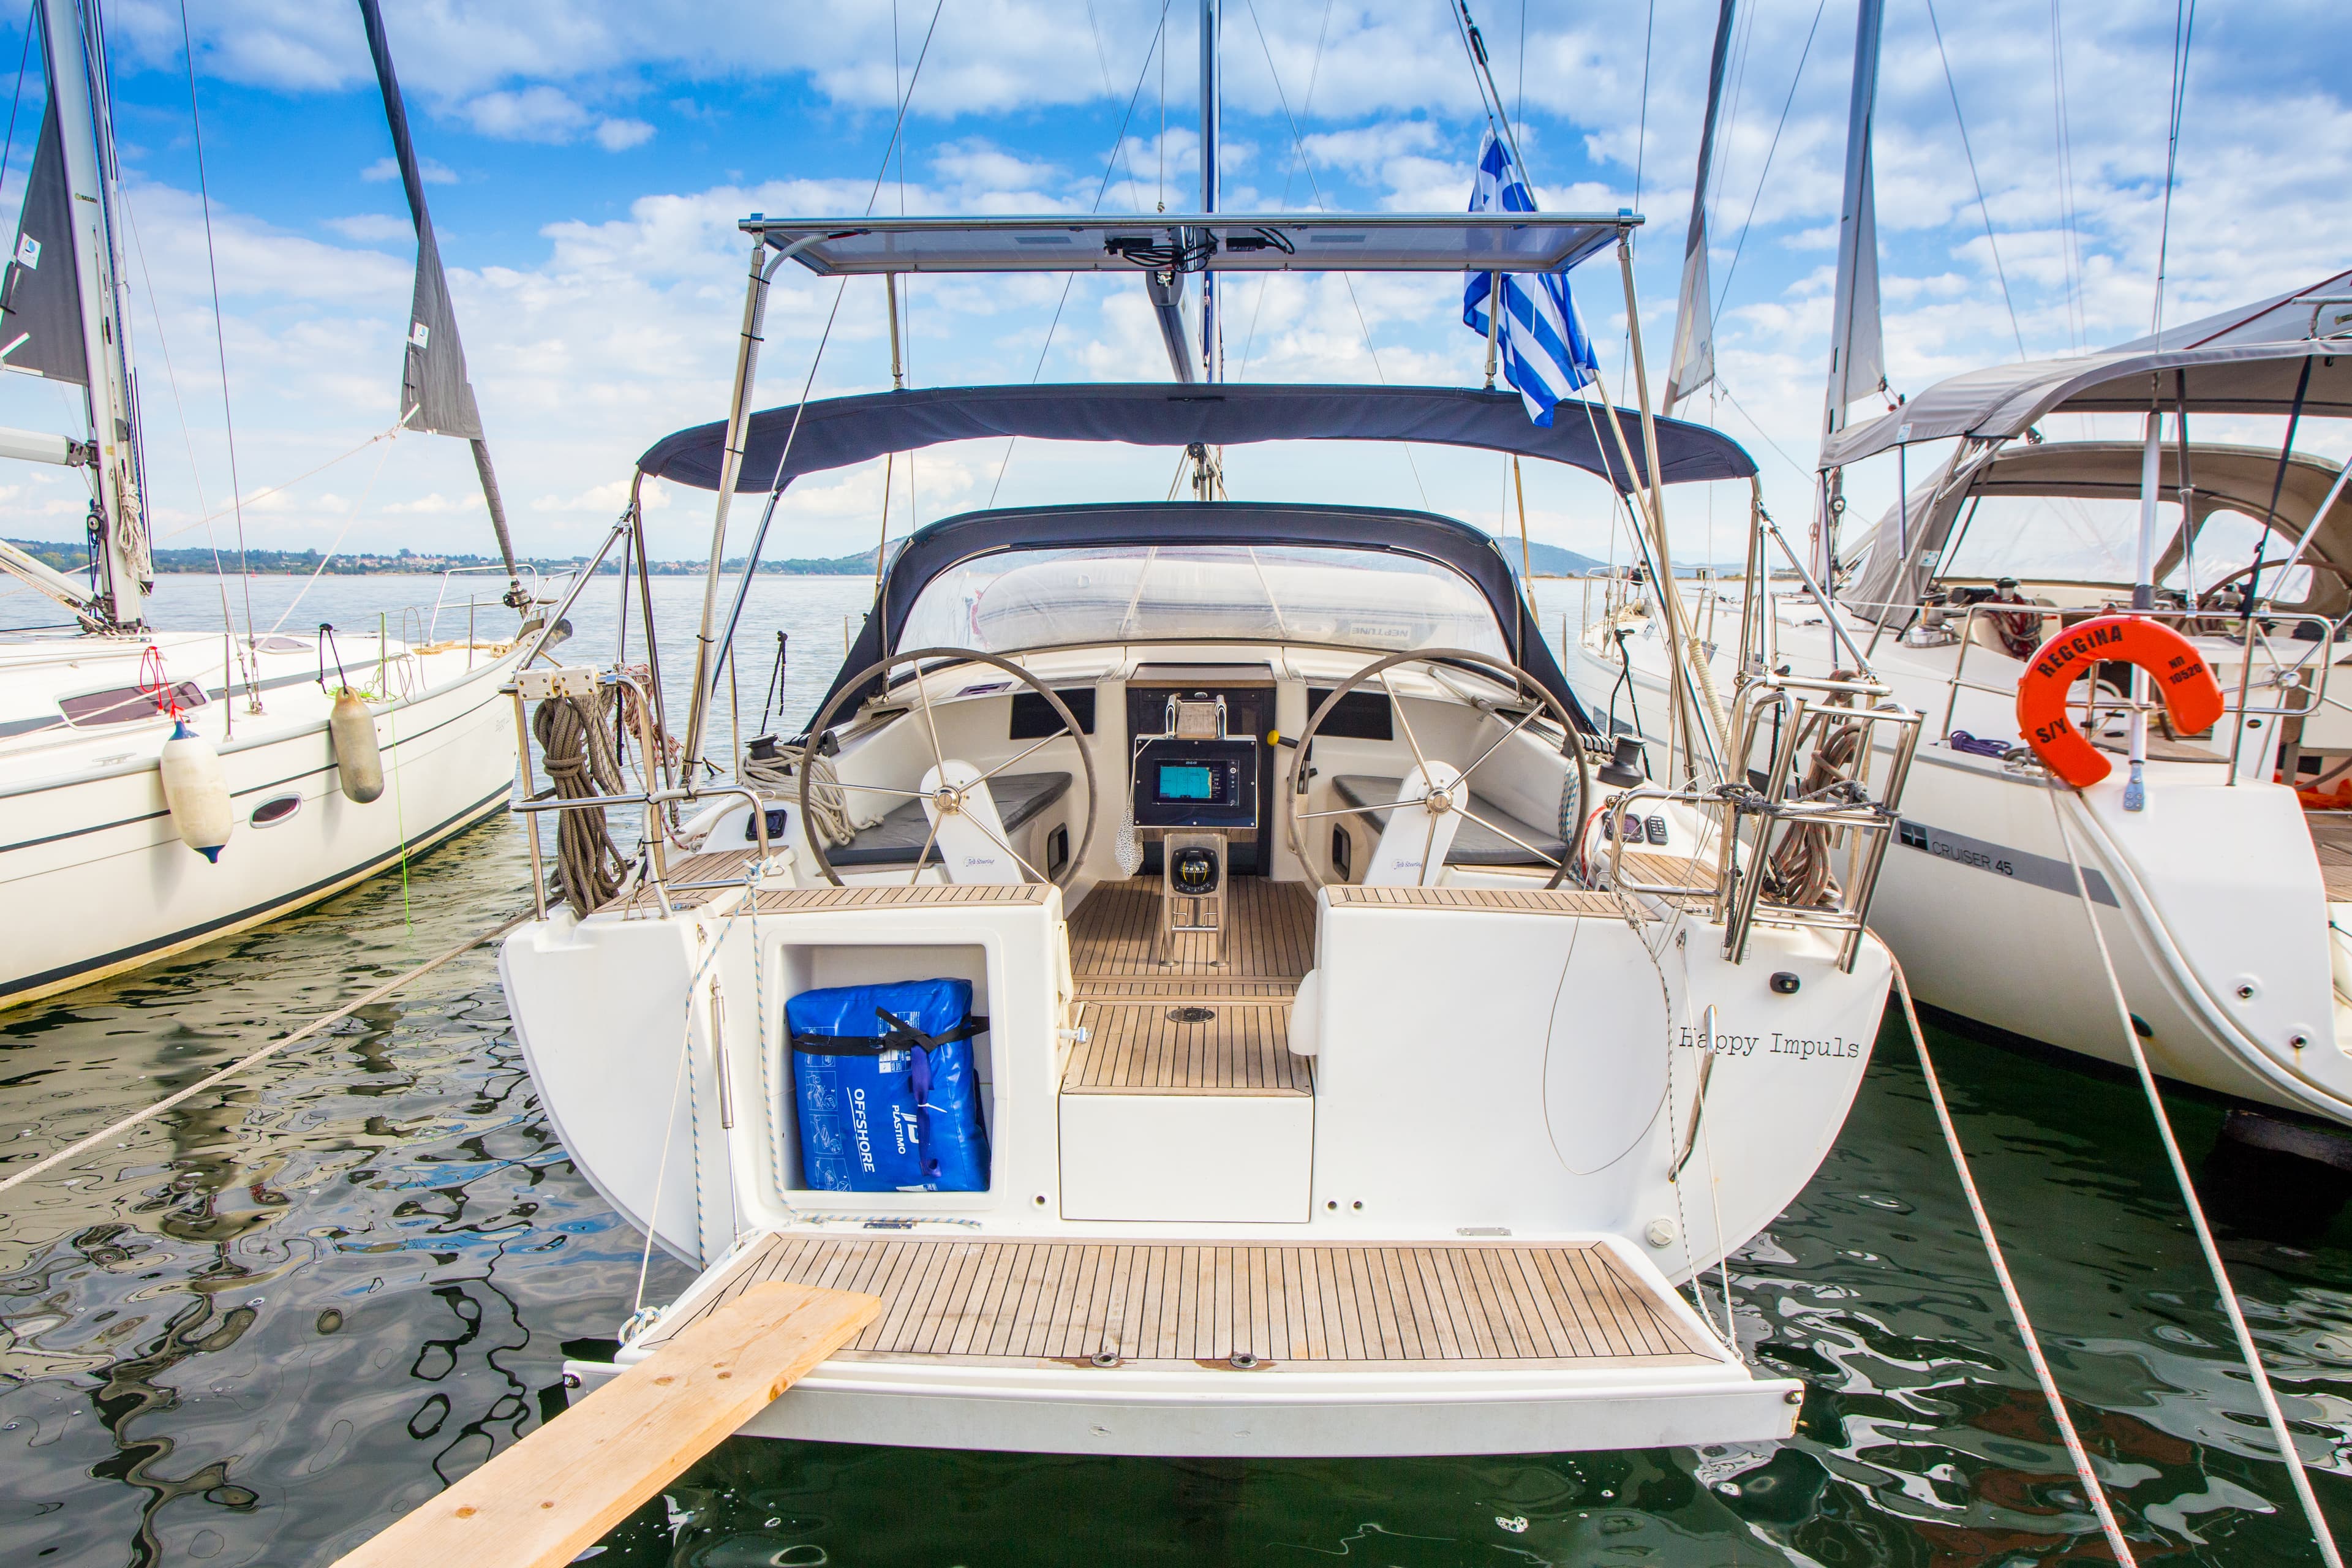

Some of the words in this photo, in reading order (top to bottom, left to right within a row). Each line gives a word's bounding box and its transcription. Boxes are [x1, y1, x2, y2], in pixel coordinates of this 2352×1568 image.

[1351, 627, 1409, 637] NEPTUNE
[2037, 625, 2123, 678] REGGINA
[2169, 663, 2203, 685] 10520
[2035, 718, 2068, 744] S/Y
[1932, 841, 1991, 870] CRUISER
[1995, 860, 2013, 876] 45
[1678, 1027, 1760, 1057] Happy
[1770, 1033, 1860, 1060] Impuls
[854, 1088, 875, 1174] OFFSHORE
[891, 1104, 906, 1155] PLASTIMO
